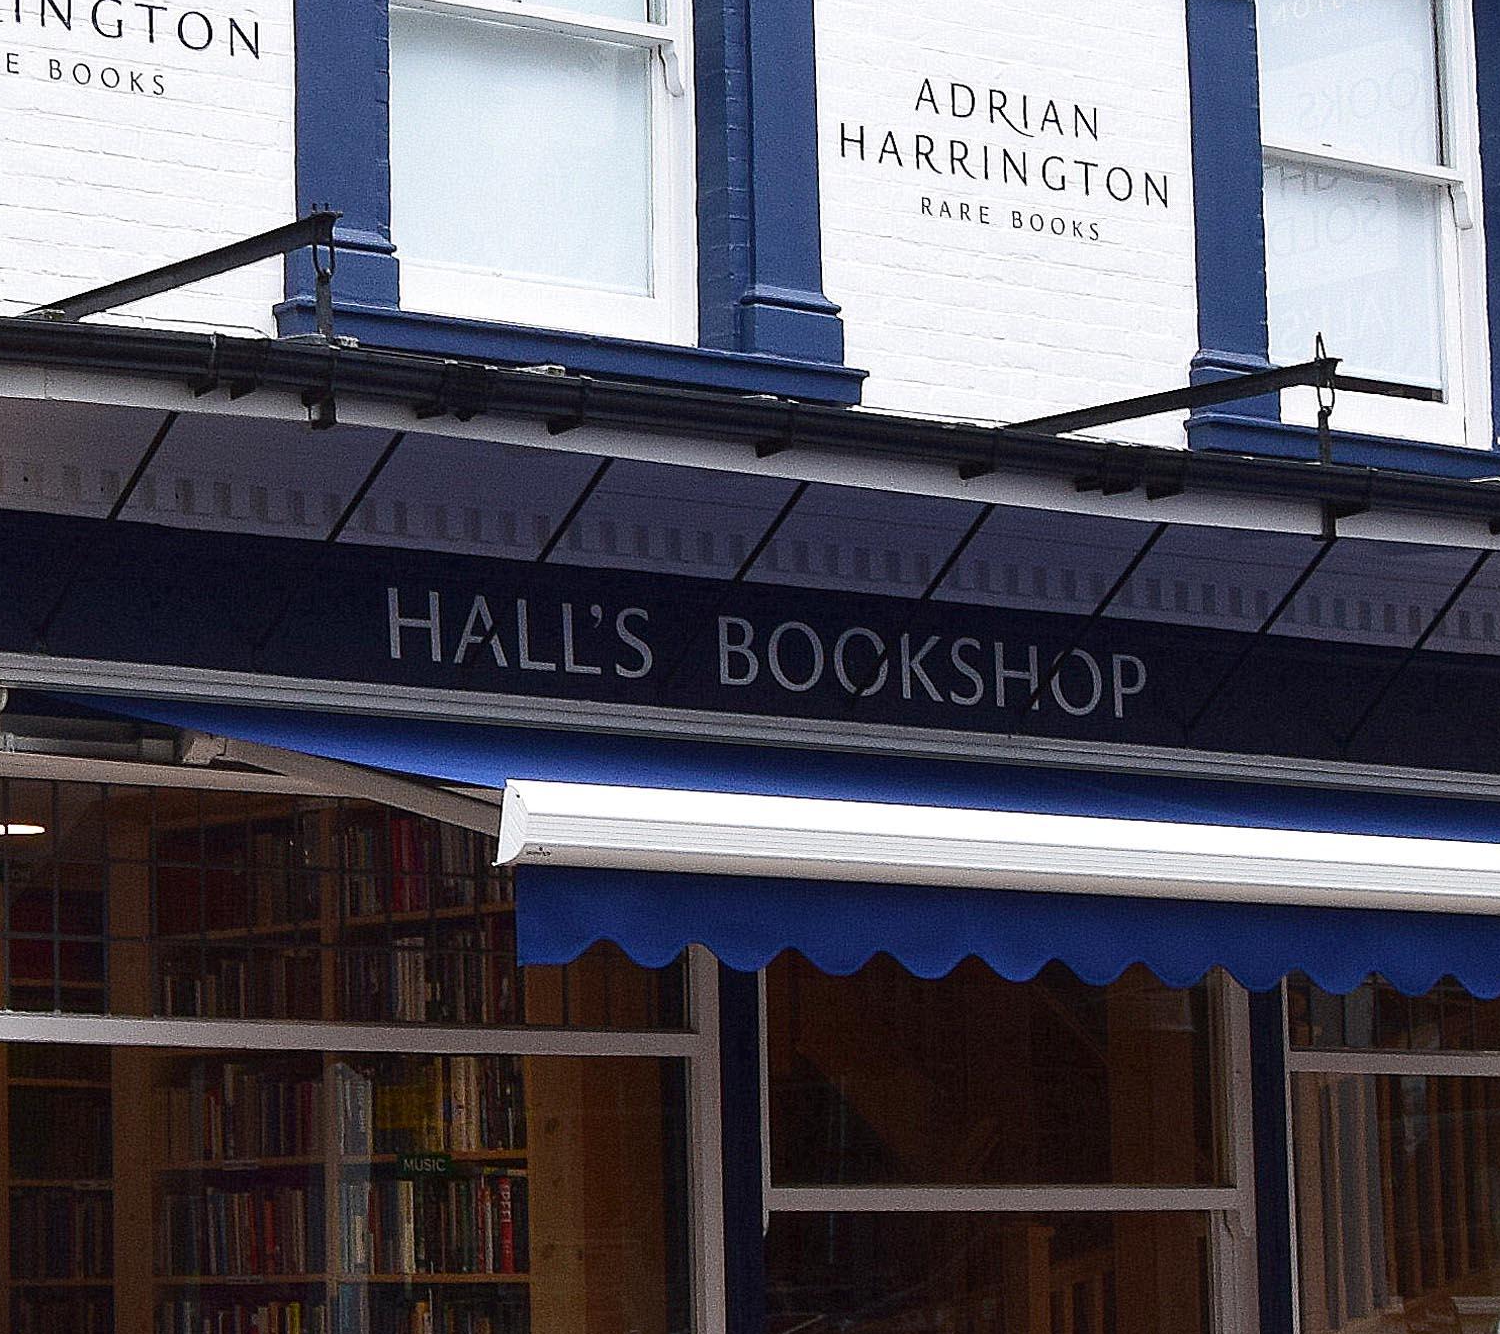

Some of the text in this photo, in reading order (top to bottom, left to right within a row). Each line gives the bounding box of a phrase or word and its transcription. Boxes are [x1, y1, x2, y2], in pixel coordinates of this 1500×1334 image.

[49, 57, 168, 97] BOOKS
[916, 77, 1101, 139] ADRIAN
[839, 122, 1171, 208] HARRINGTON
[920, 195, 1102, 243] RARE BOOKS
[384, 585, 654, 679] HALL’S
[718, 613, 1148, 721] BOOKSHOP
[403, 1158, 447, 1172] MUSIC
